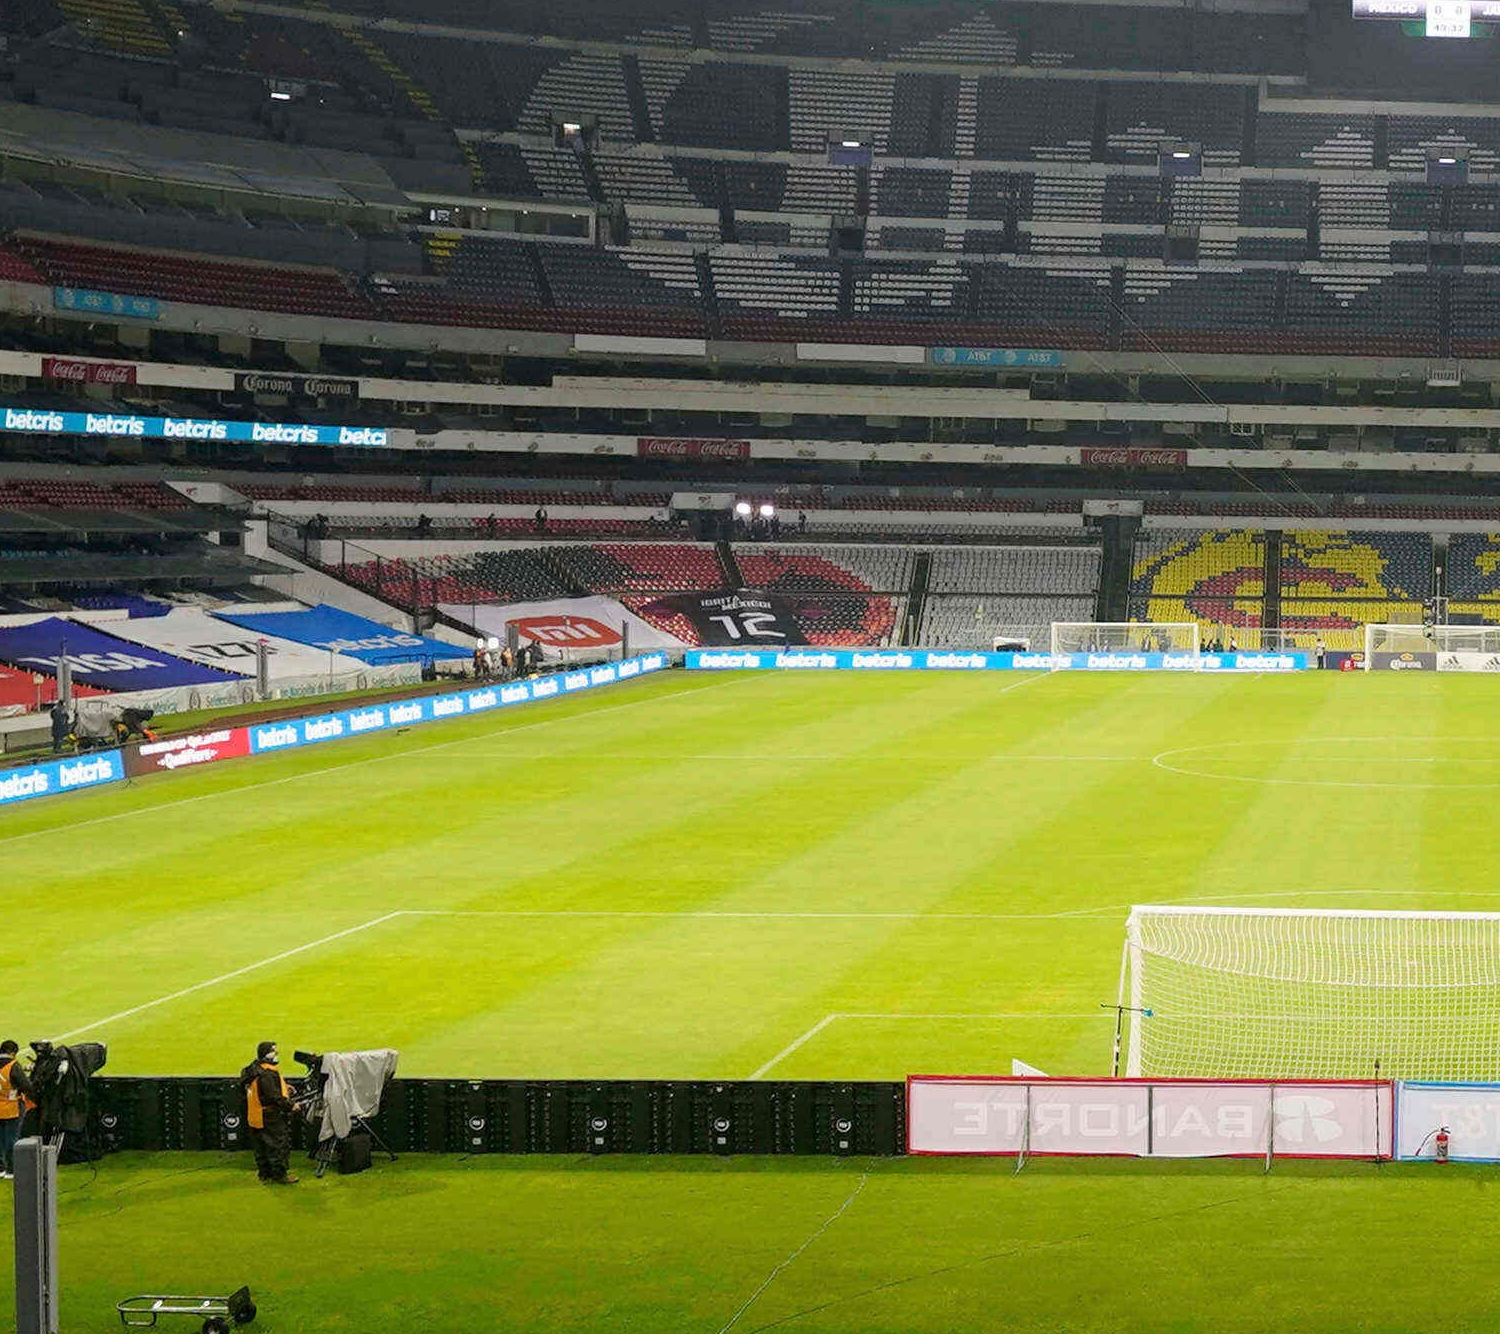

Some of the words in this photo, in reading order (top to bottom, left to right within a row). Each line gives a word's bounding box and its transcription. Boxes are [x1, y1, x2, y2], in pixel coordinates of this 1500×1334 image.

[5, 409, 63, 431] betcris
[86, 414, 144, 435] betcris
[164, 418, 227, 439] betcris
[253, 422, 318, 443] betcris
[17, 652, 168, 674] VISA
[60, 757, 112, 787] betcris
